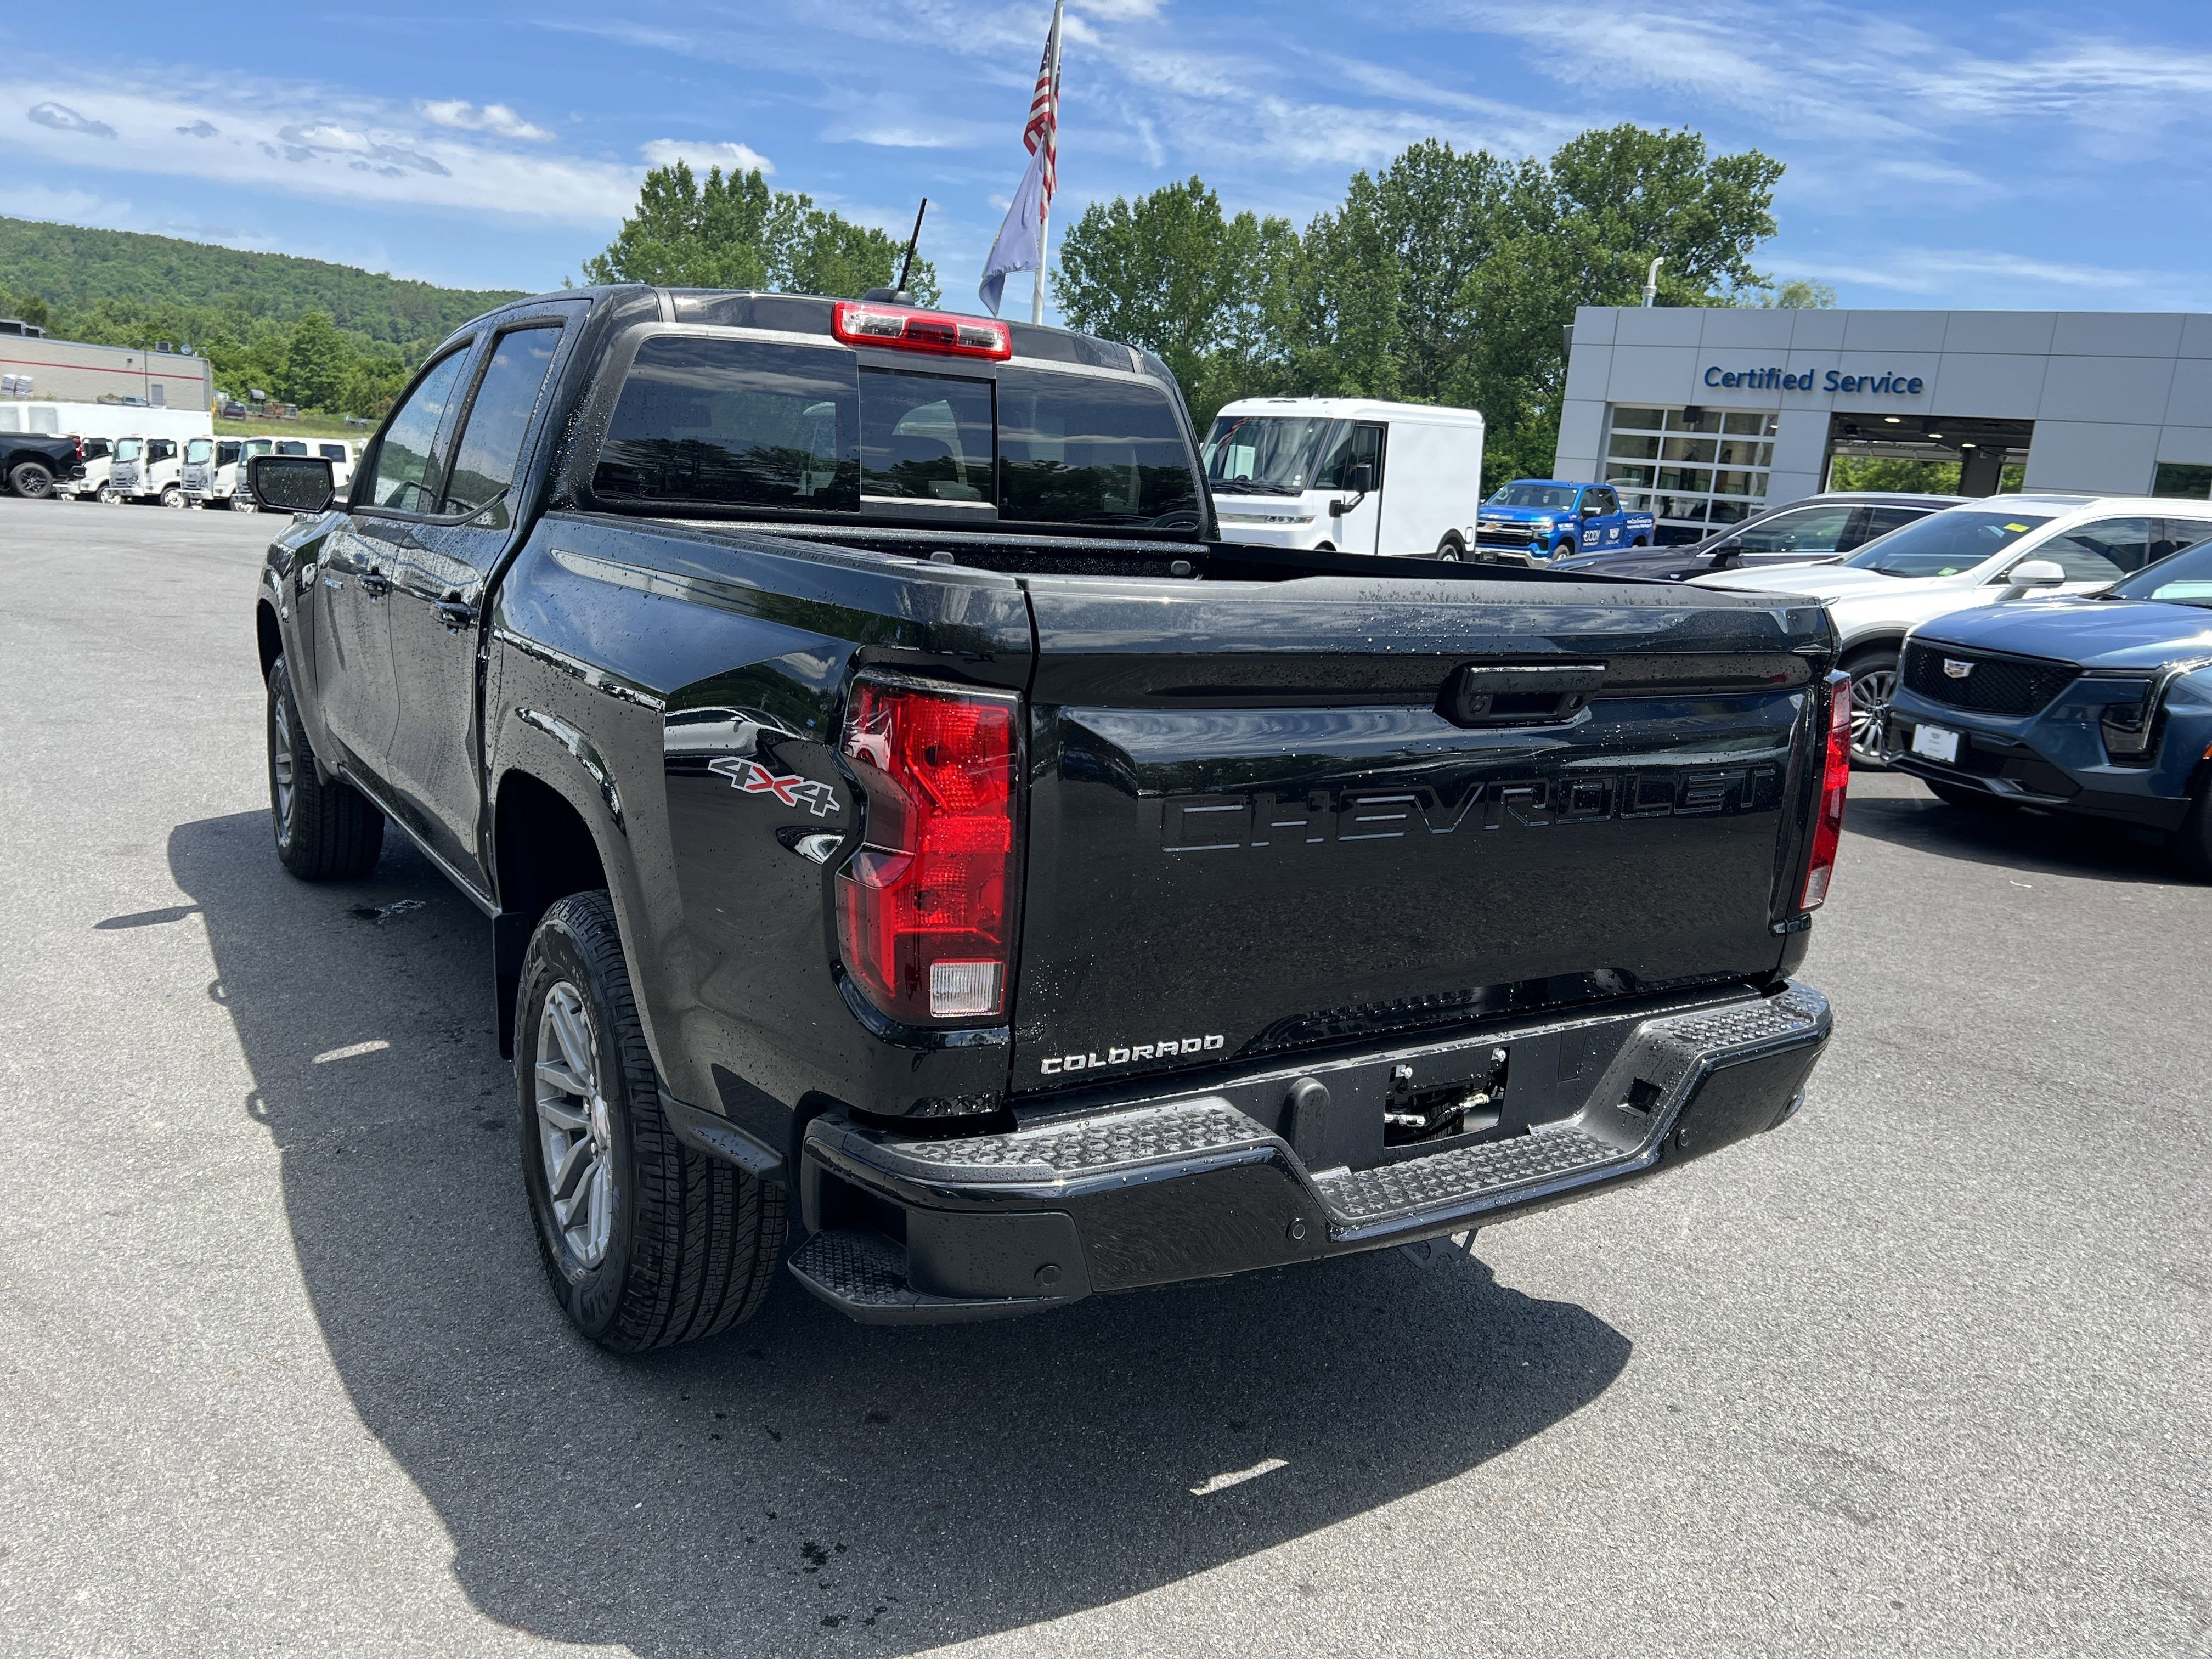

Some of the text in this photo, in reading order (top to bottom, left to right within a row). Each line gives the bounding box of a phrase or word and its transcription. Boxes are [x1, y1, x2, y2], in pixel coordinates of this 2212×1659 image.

[1704, 366, 1923, 394] Certified Service
[1161, 763, 1776, 852] CHEVROLET
[1041, 1035, 1224, 1074] COLORADO
